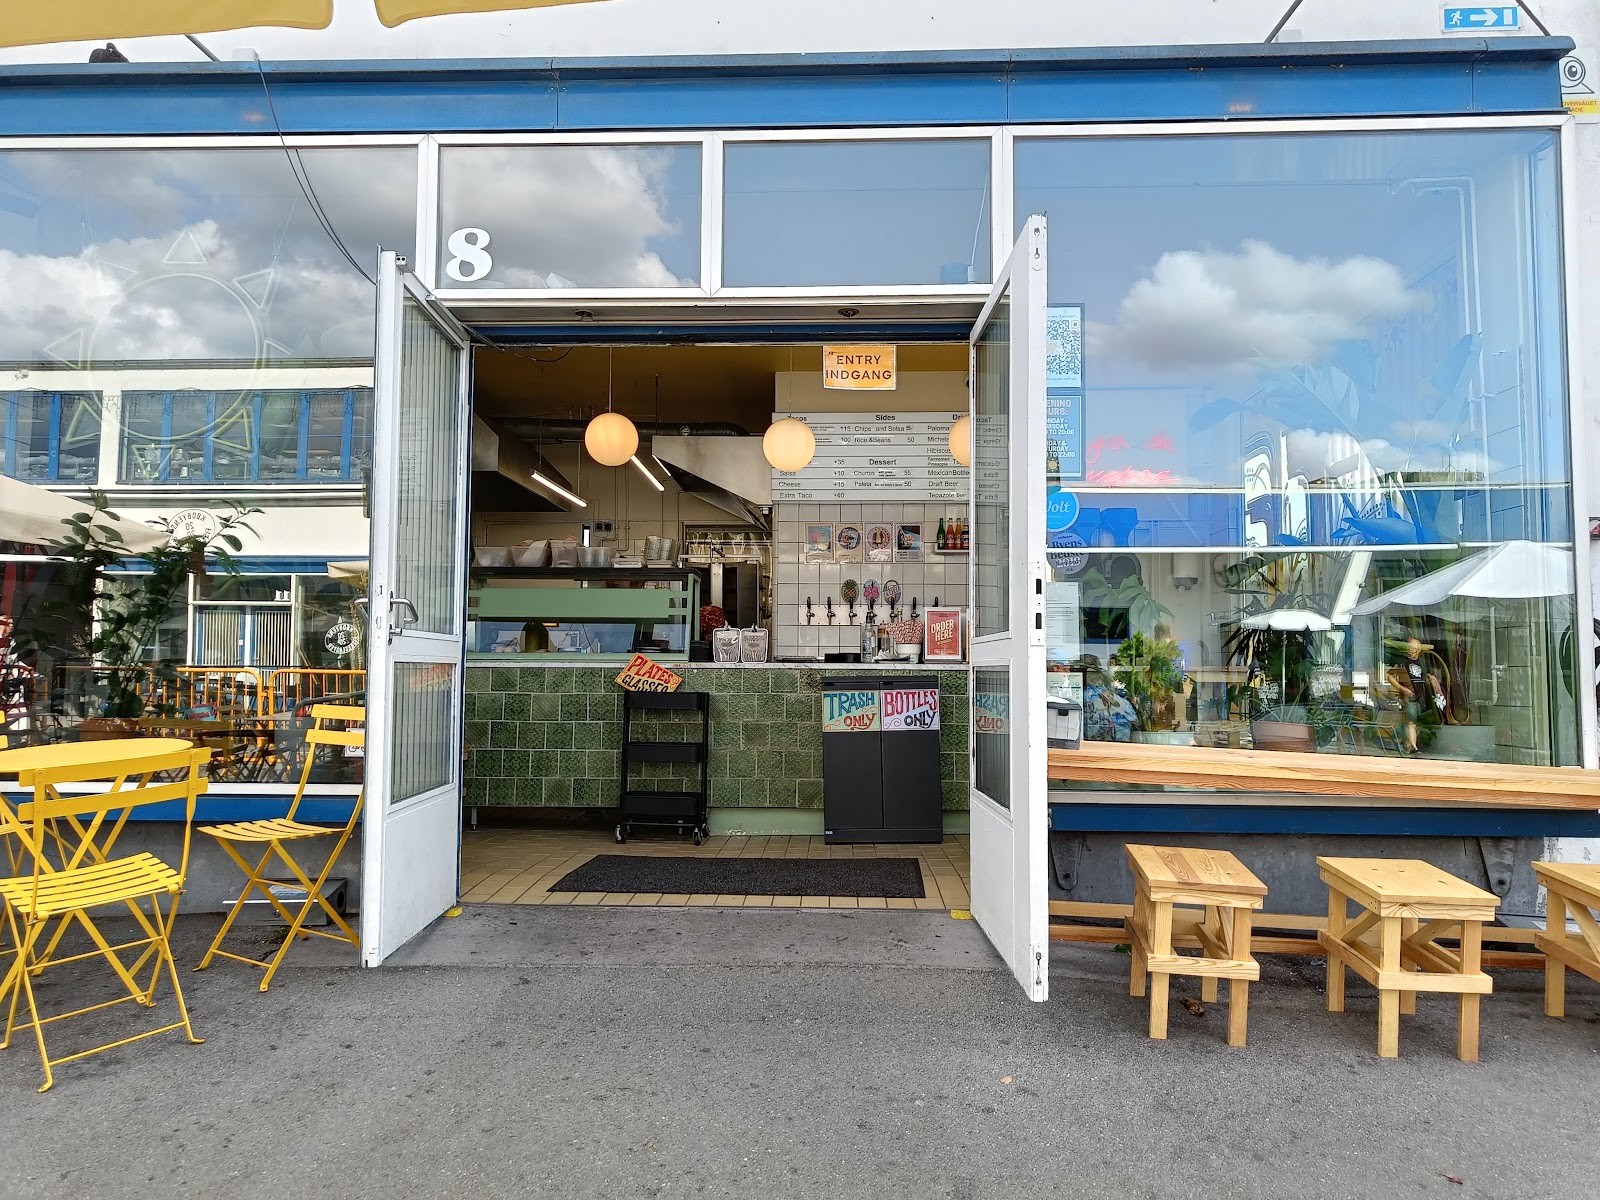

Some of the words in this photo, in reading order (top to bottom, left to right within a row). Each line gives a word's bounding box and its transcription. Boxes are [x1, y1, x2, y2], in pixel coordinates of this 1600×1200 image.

[446, 227, 493, 281] 8
[837, 355, 881, 364] ENTRY
[826, 370, 892, 380] INDGANG
[1048, 408, 1068, 416] URS:
[931, 620, 954, 634] ORDER
[936, 628, 954, 642] HERE
[626, 654, 674, 684] PLATES
[824, 692, 875, 721] TRASH
[884, 690, 938, 717] BOTTLES
[844, 713, 878, 730] ONLY
[904, 711, 938, 729] ONLY
